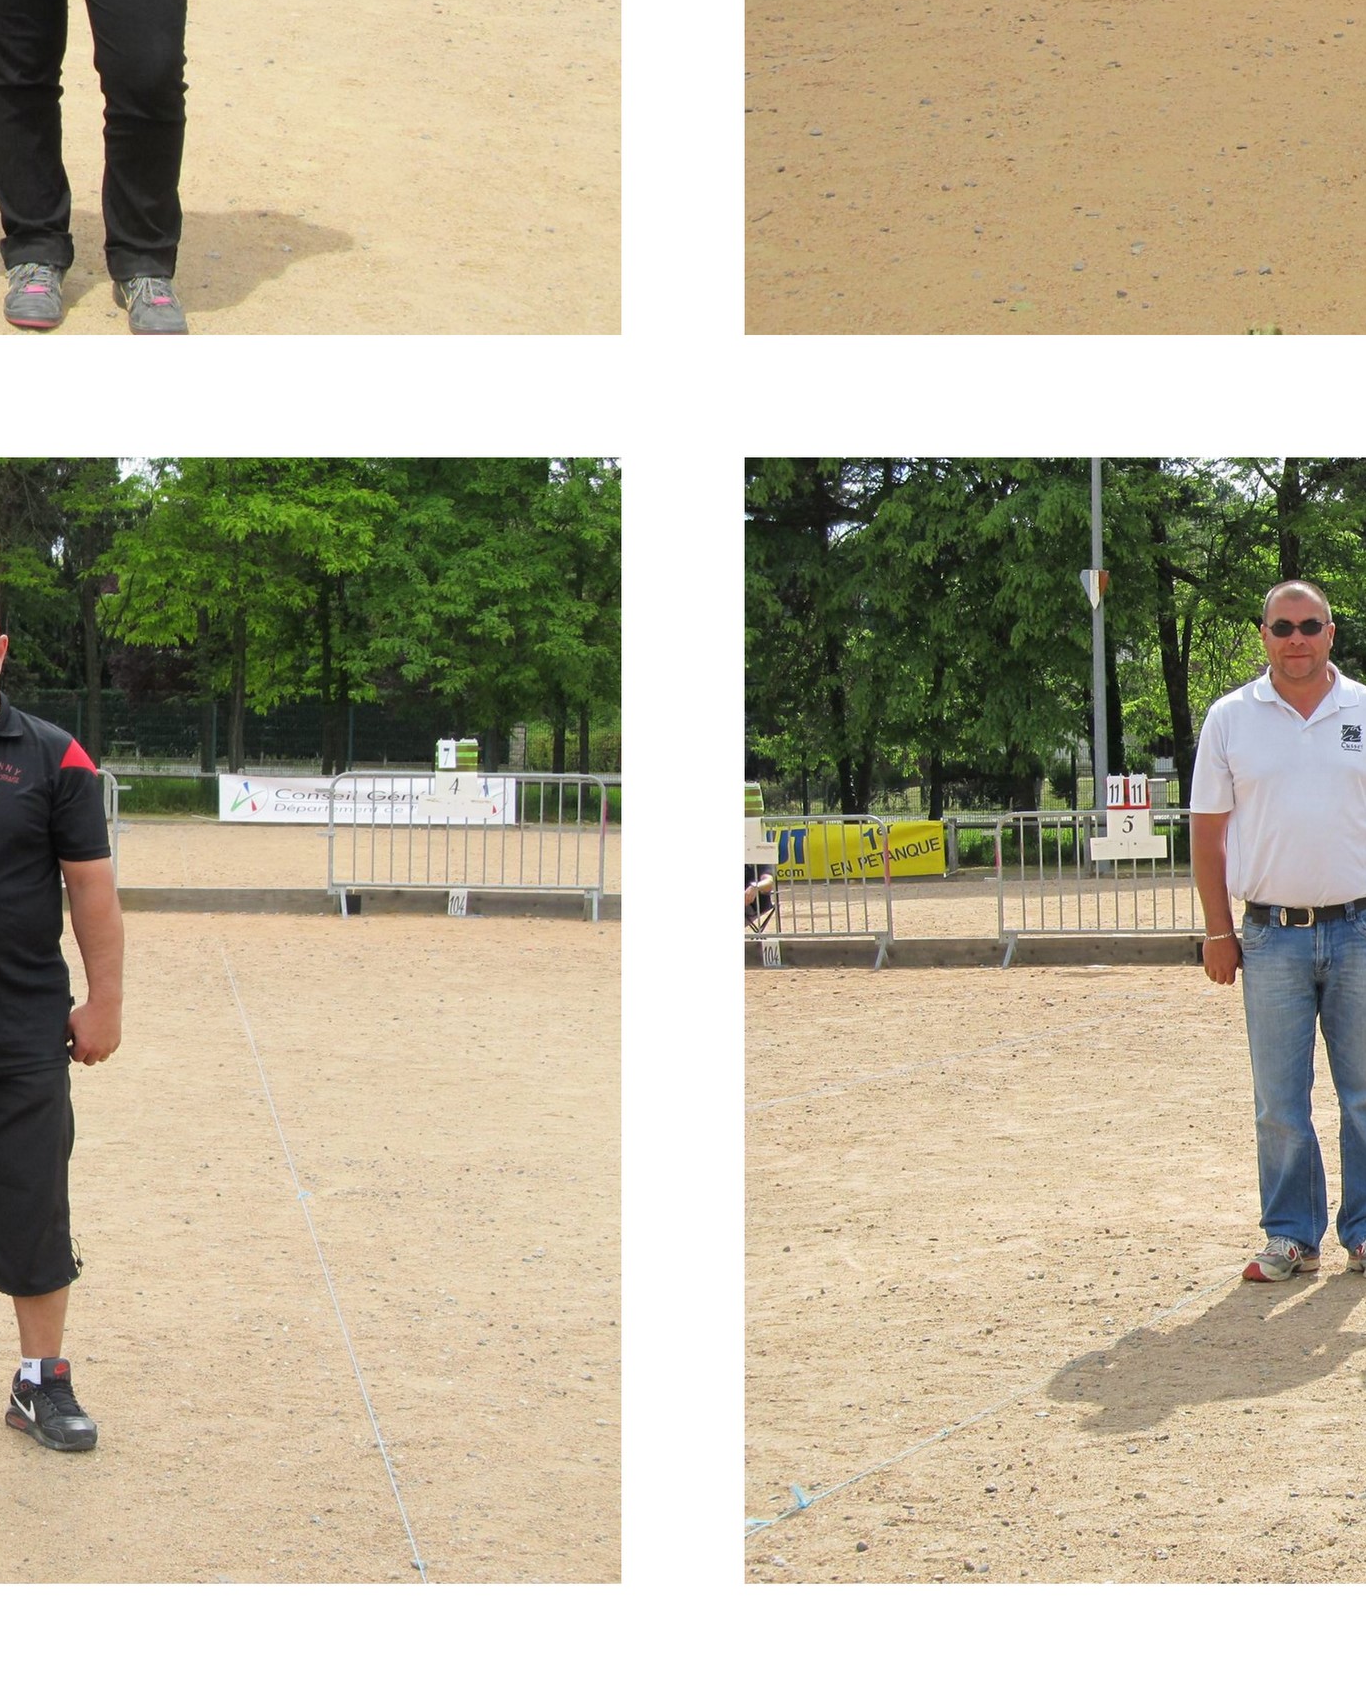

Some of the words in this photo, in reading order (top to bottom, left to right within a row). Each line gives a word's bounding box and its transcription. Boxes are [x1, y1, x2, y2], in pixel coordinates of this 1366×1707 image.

[443, 747, 450, 766] 7
[448, 777, 460, 795] 4
[1108, 783, 1122, 804] 11
[1130, 783, 1143, 804] 11
[1122, 815, 1135, 835] 5
[863, 824, 893, 850] 1er
[830, 861, 854, 878] EN
[449, 895, 465, 915] 104
[764, 945, 779, 966] 104
